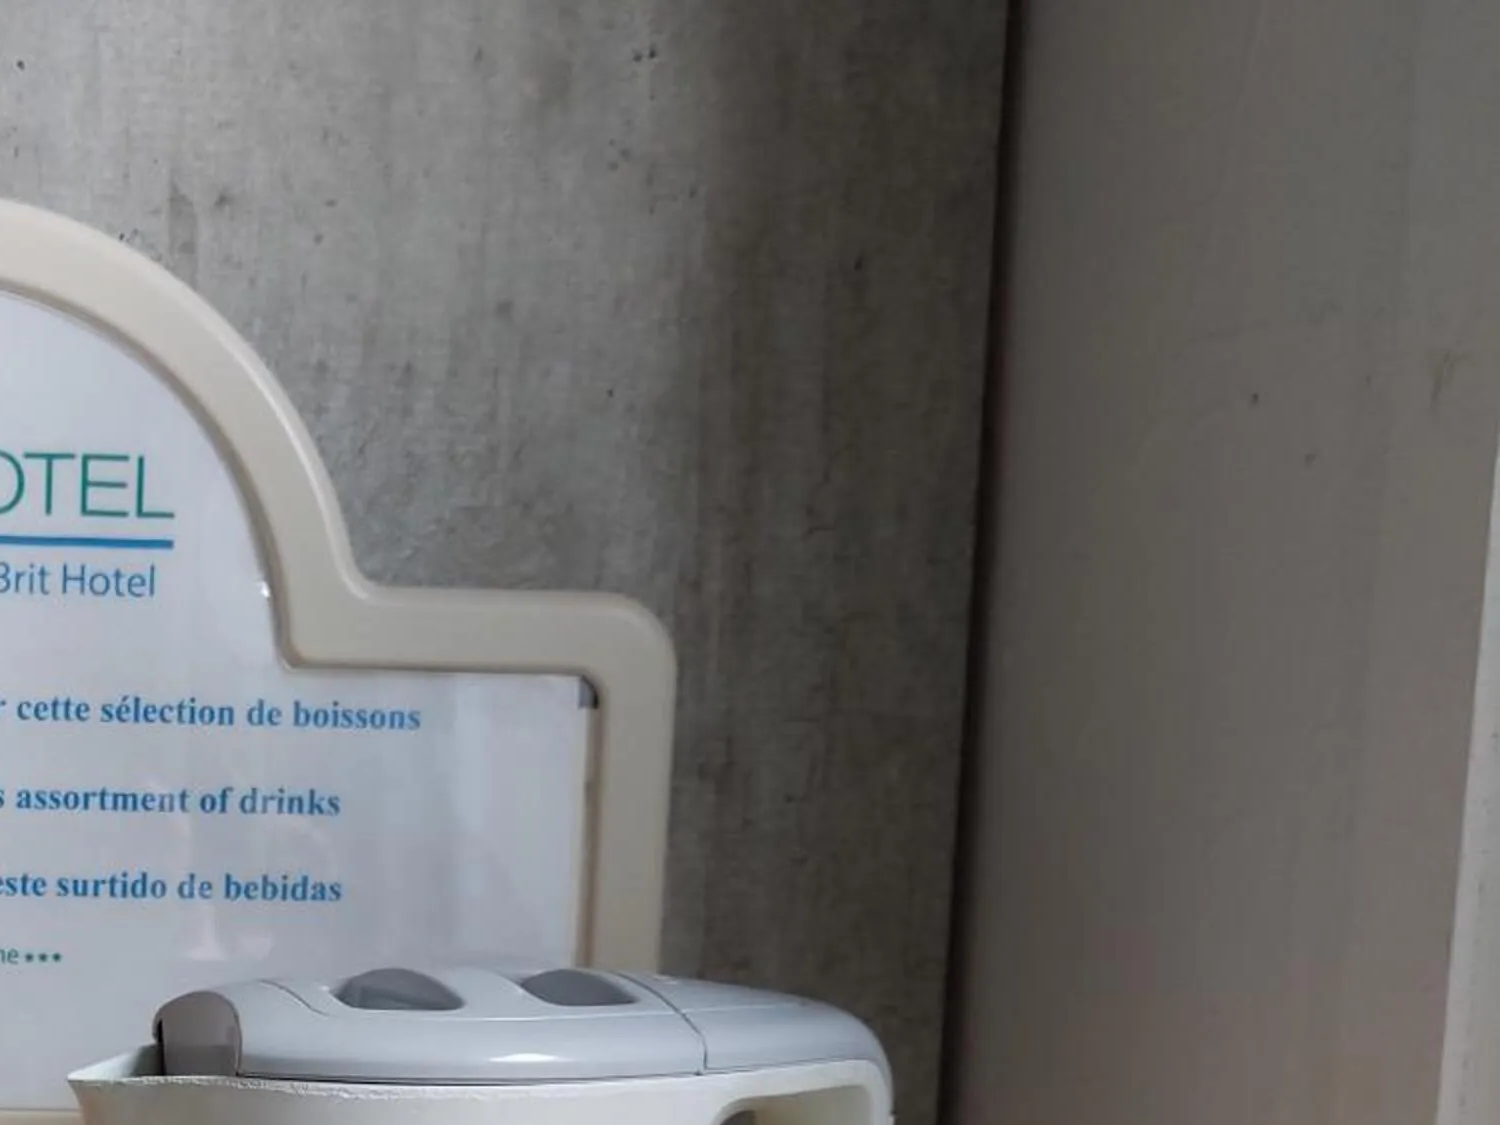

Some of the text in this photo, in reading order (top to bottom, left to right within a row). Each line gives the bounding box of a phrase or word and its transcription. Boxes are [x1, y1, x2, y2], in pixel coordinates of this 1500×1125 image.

[62, 564, 156, 597] Hotel
[17, 697, 90, 723] cette
[100, 694, 234, 726] sélection
[247, 700, 282, 727] de
[292, 701, 421, 731] boissons
[16, 786, 190, 814] assortment
[200, 787, 233, 815] of
[239, 787, 341, 817] drinks
[57, 870, 167, 899] surtido
[178, 873, 212, 900] de
[224, 873, 342, 903] bebidas
